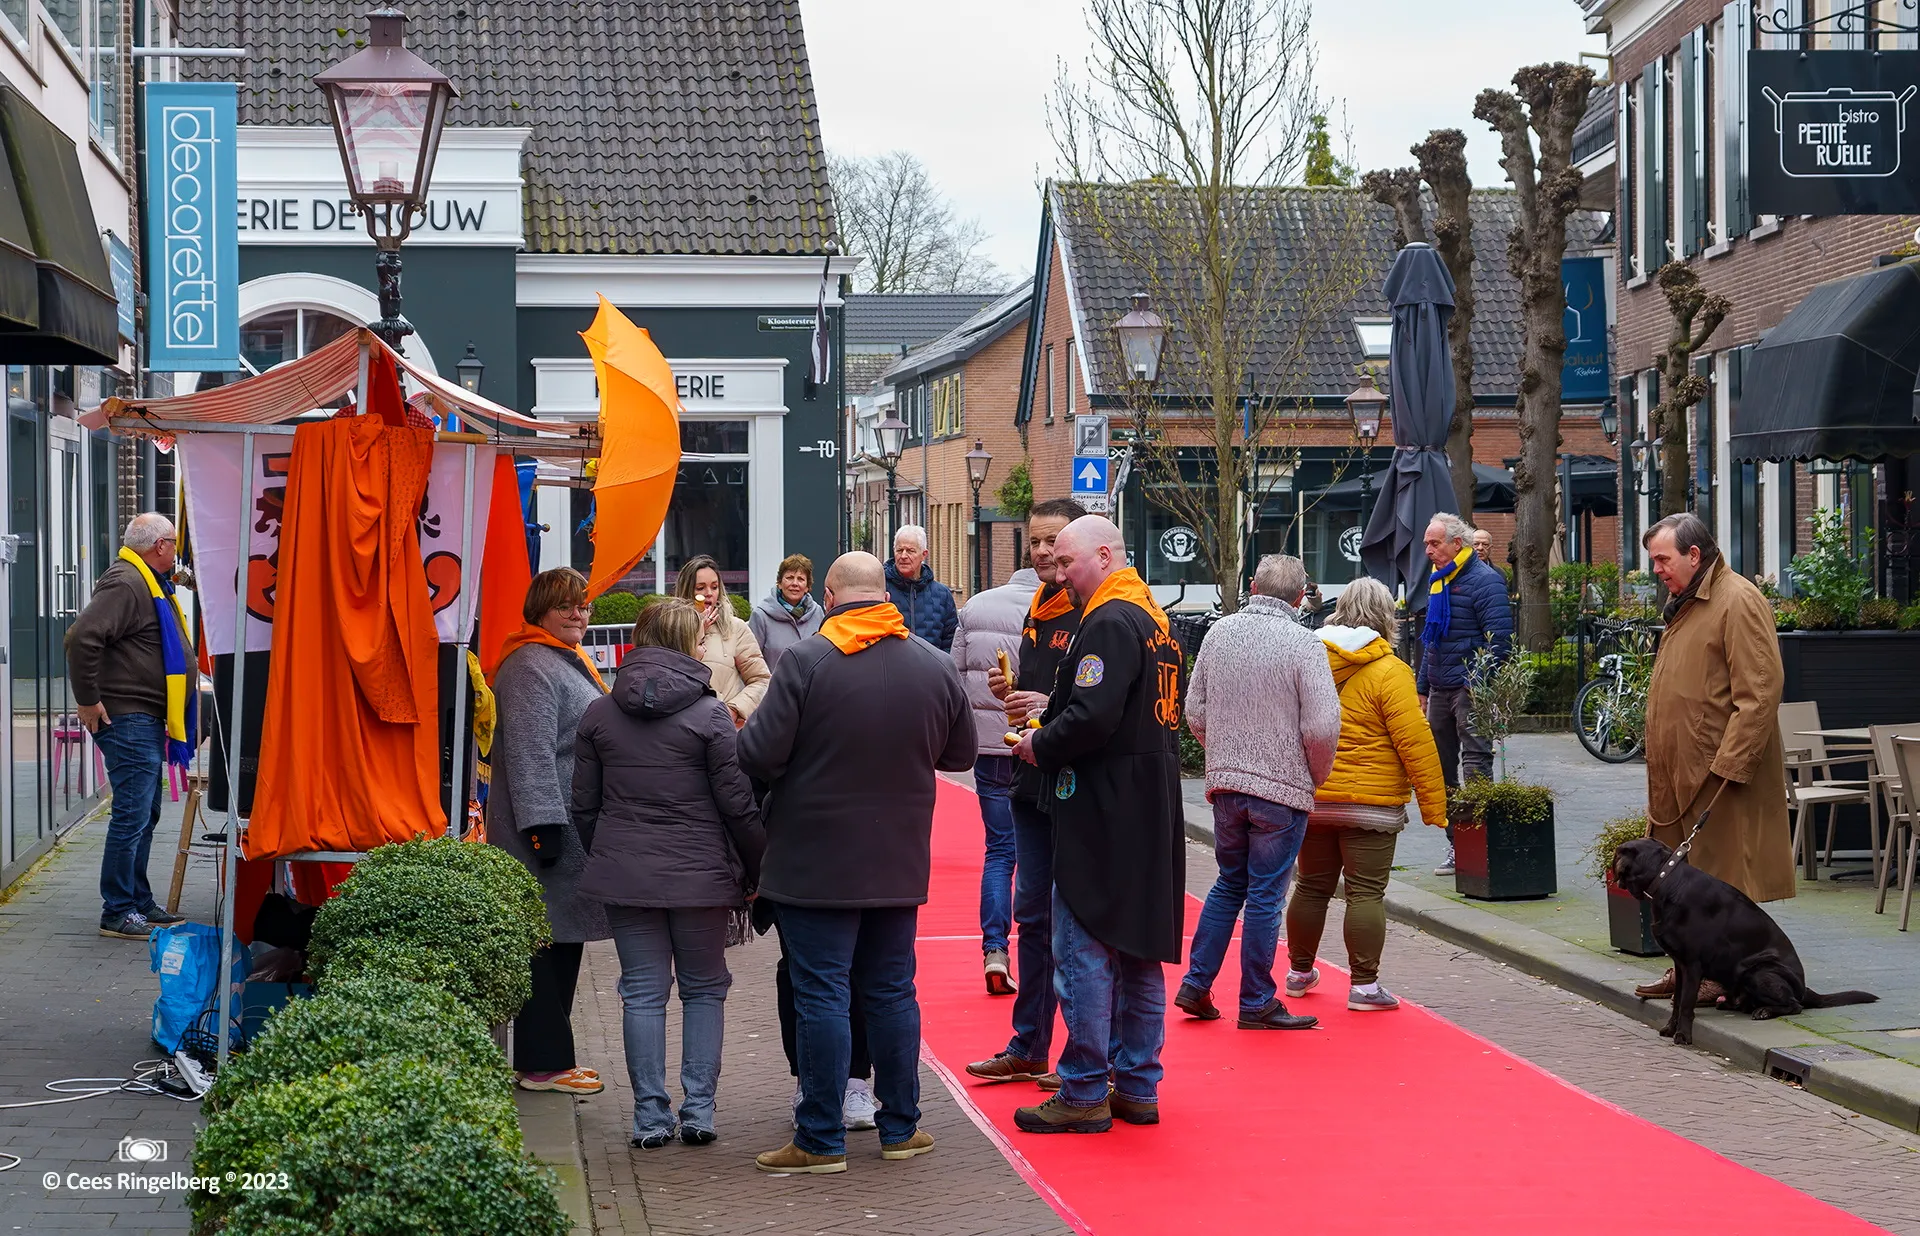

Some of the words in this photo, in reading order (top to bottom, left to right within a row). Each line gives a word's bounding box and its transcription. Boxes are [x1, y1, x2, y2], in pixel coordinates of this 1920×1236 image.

[1839, 104, 1879, 123] bistro
[1798, 123, 1847, 144] PETITE
[1816, 144, 1872, 166] RUELLE
[312, 199, 356, 230] DE
[166, 113, 220, 341] decorette
[767, 317, 817, 325] Kloosterstra
